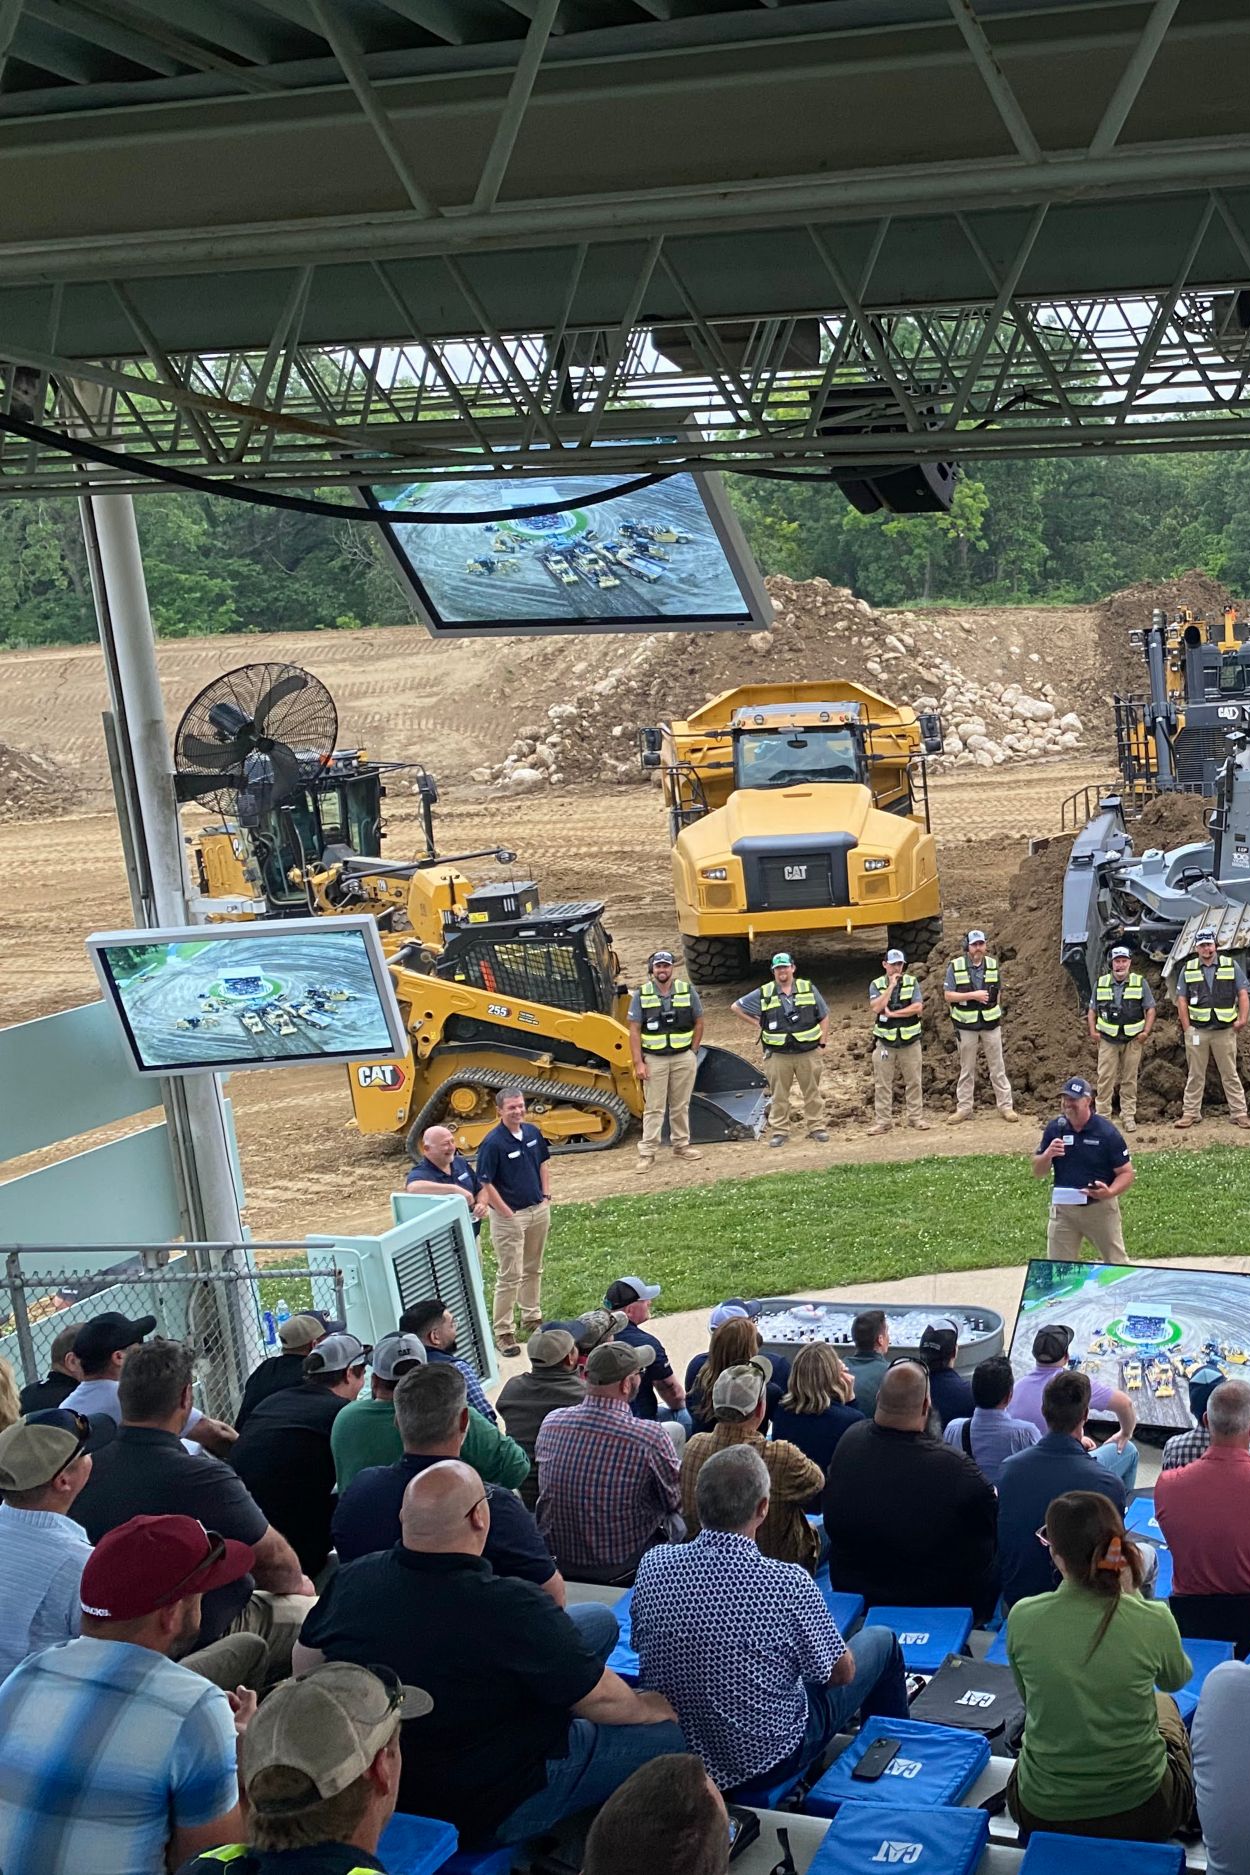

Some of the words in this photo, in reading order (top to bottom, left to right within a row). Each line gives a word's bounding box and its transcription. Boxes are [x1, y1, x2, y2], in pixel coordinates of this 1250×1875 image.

[1218, 706, 1239, 720] CAT
[784, 865, 807, 880] CAT
[488, 1004, 508, 1018] 255
[358, 1066, 394, 1087] CAT
[898, 1632, 930, 1645] CAT
[954, 1689, 996, 1708] CAT
[883, 1758, 922, 1779] CAT
[871, 1840, 924, 1864] CAT
